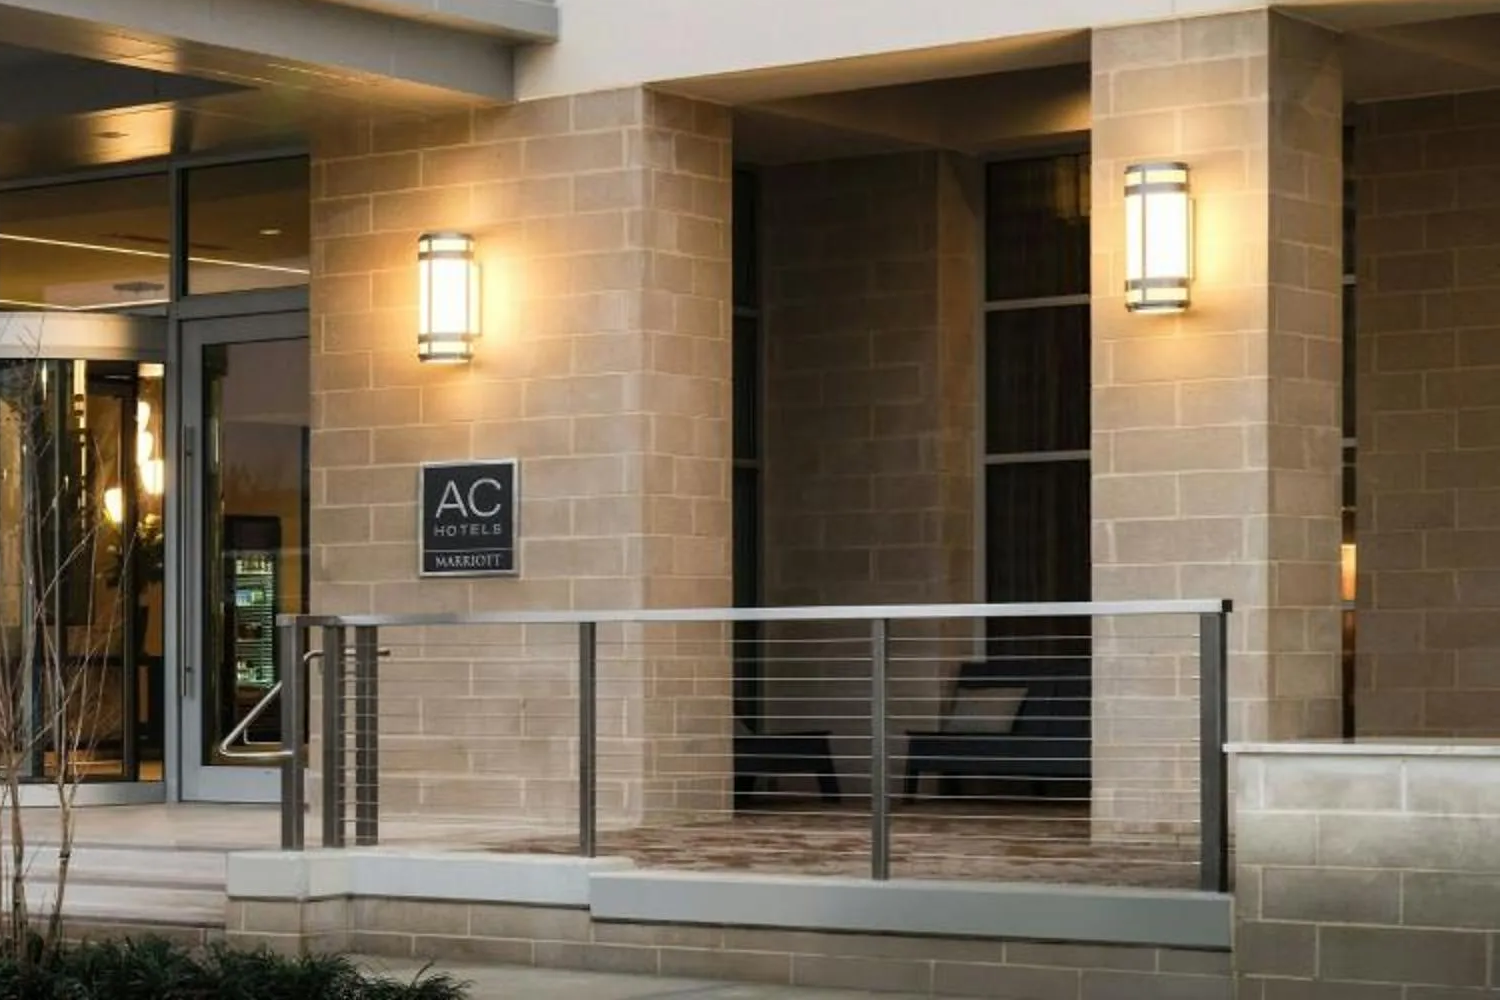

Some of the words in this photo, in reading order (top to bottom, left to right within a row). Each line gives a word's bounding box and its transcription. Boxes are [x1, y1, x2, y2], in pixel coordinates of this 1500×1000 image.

[435, 478, 501, 518] AC
[433, 524, 501, 536] HOTELS
[435, 553, 501, 567] MARRIOTT
